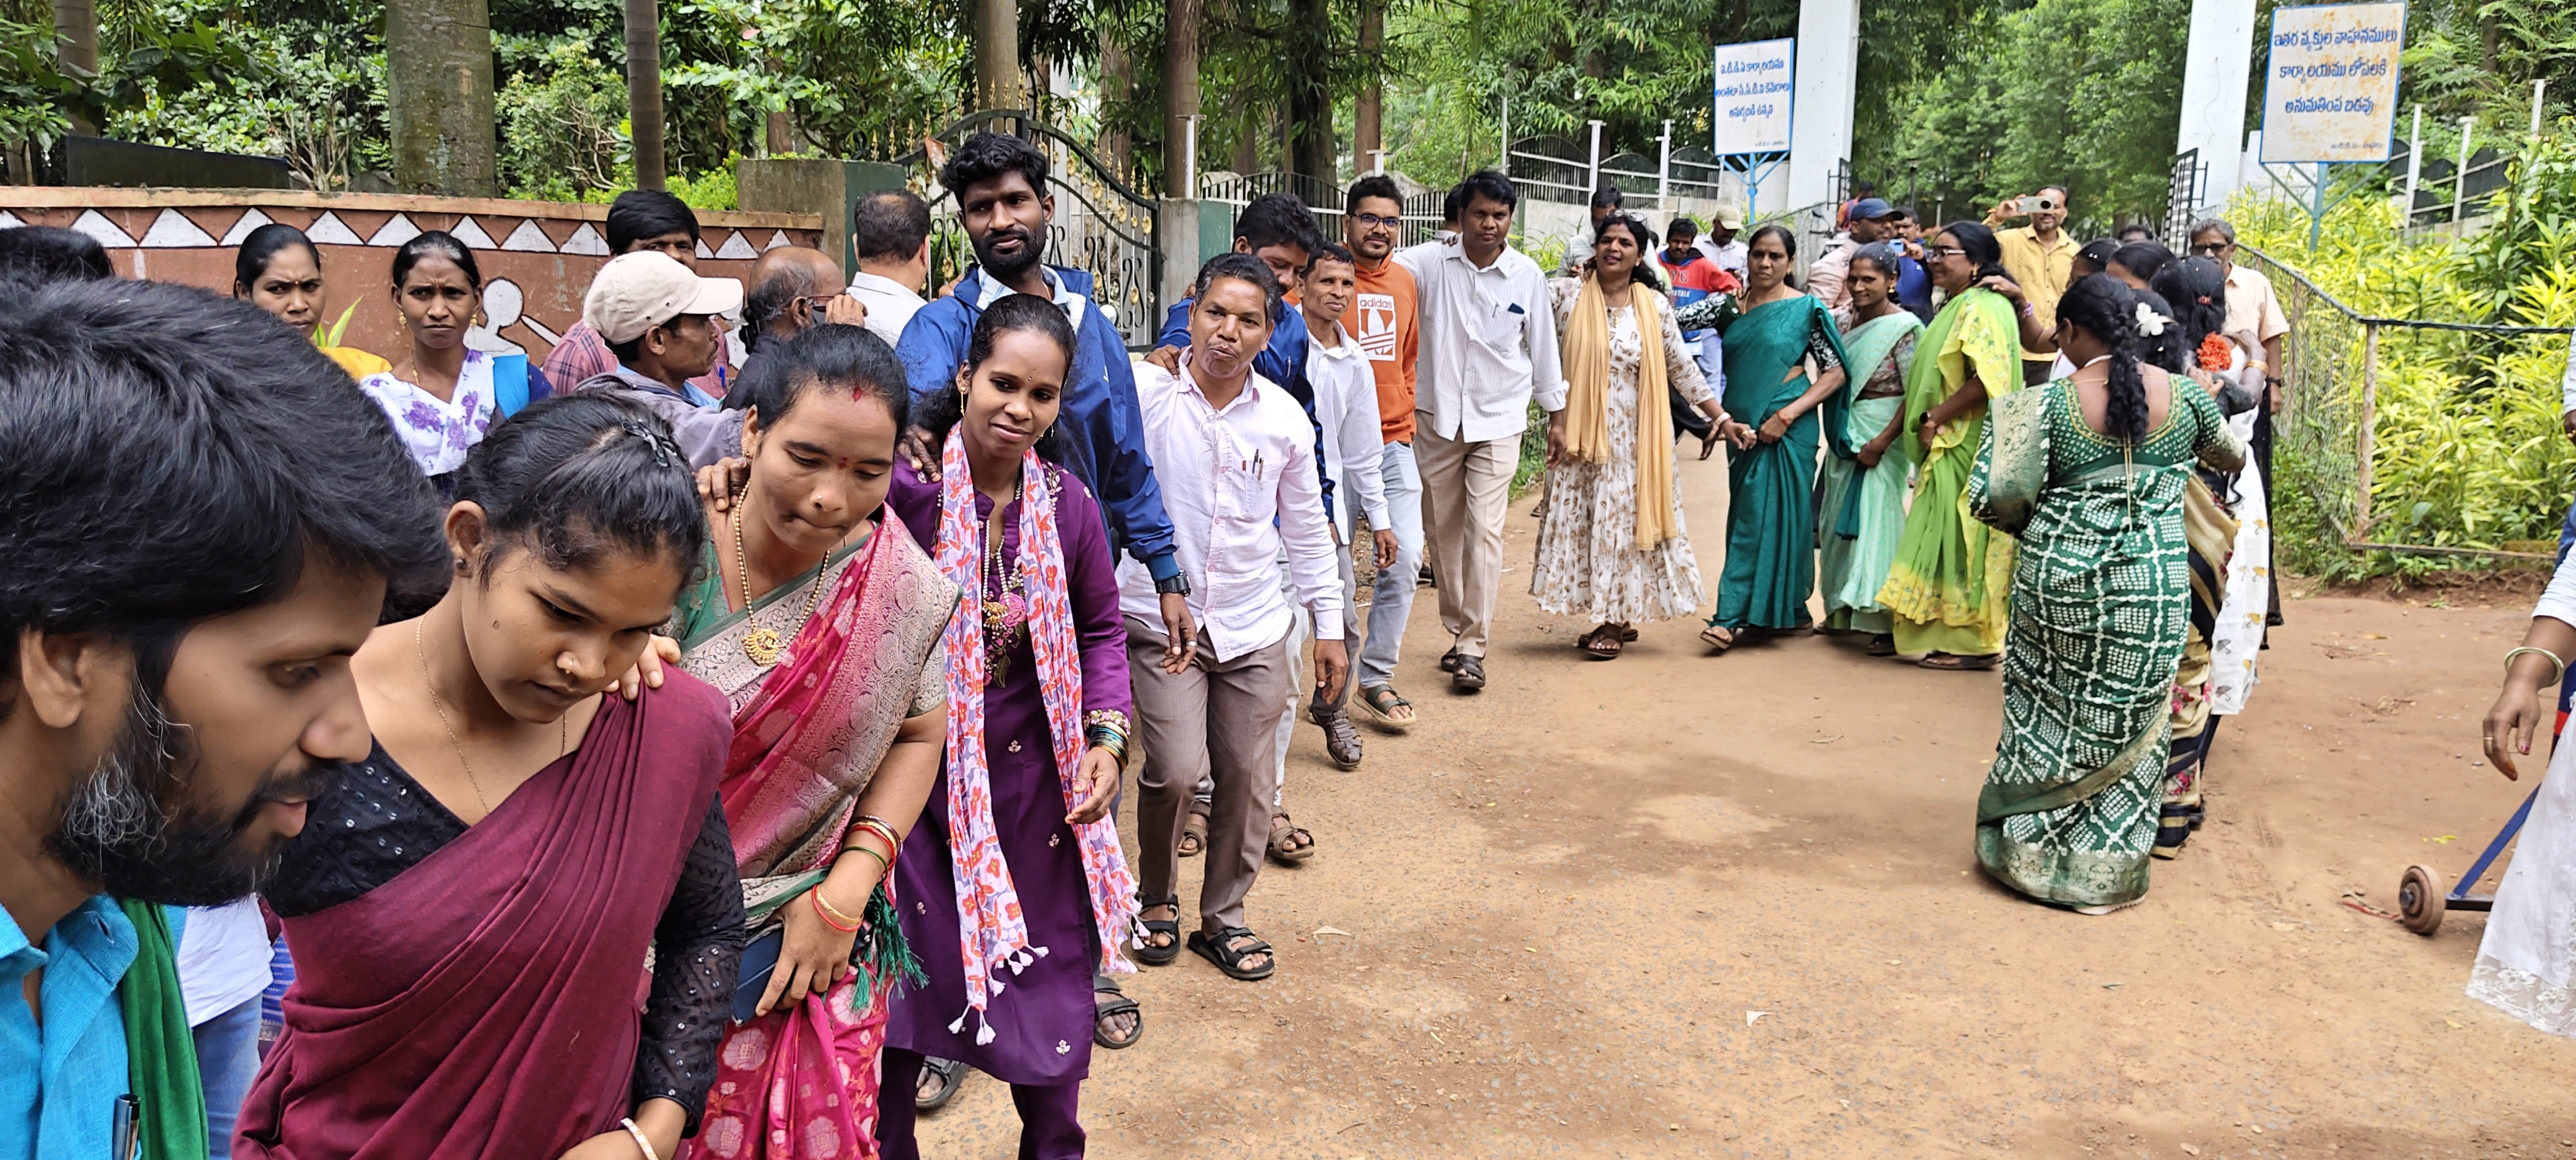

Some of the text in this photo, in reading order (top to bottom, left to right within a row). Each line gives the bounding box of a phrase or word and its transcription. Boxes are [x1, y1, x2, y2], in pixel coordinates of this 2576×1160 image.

[2274, 30, 2299, 47] ఇతర
[2301, 28, 2333, 52] వ్యక్తుల
[2279, 60, 2346, 84] కార్యాలయము
[2285, 95, 2343, 113] అనుమతింప
[1670, 269, 1688, 283] YC
[1360, 298, 1392, 309] adidas
